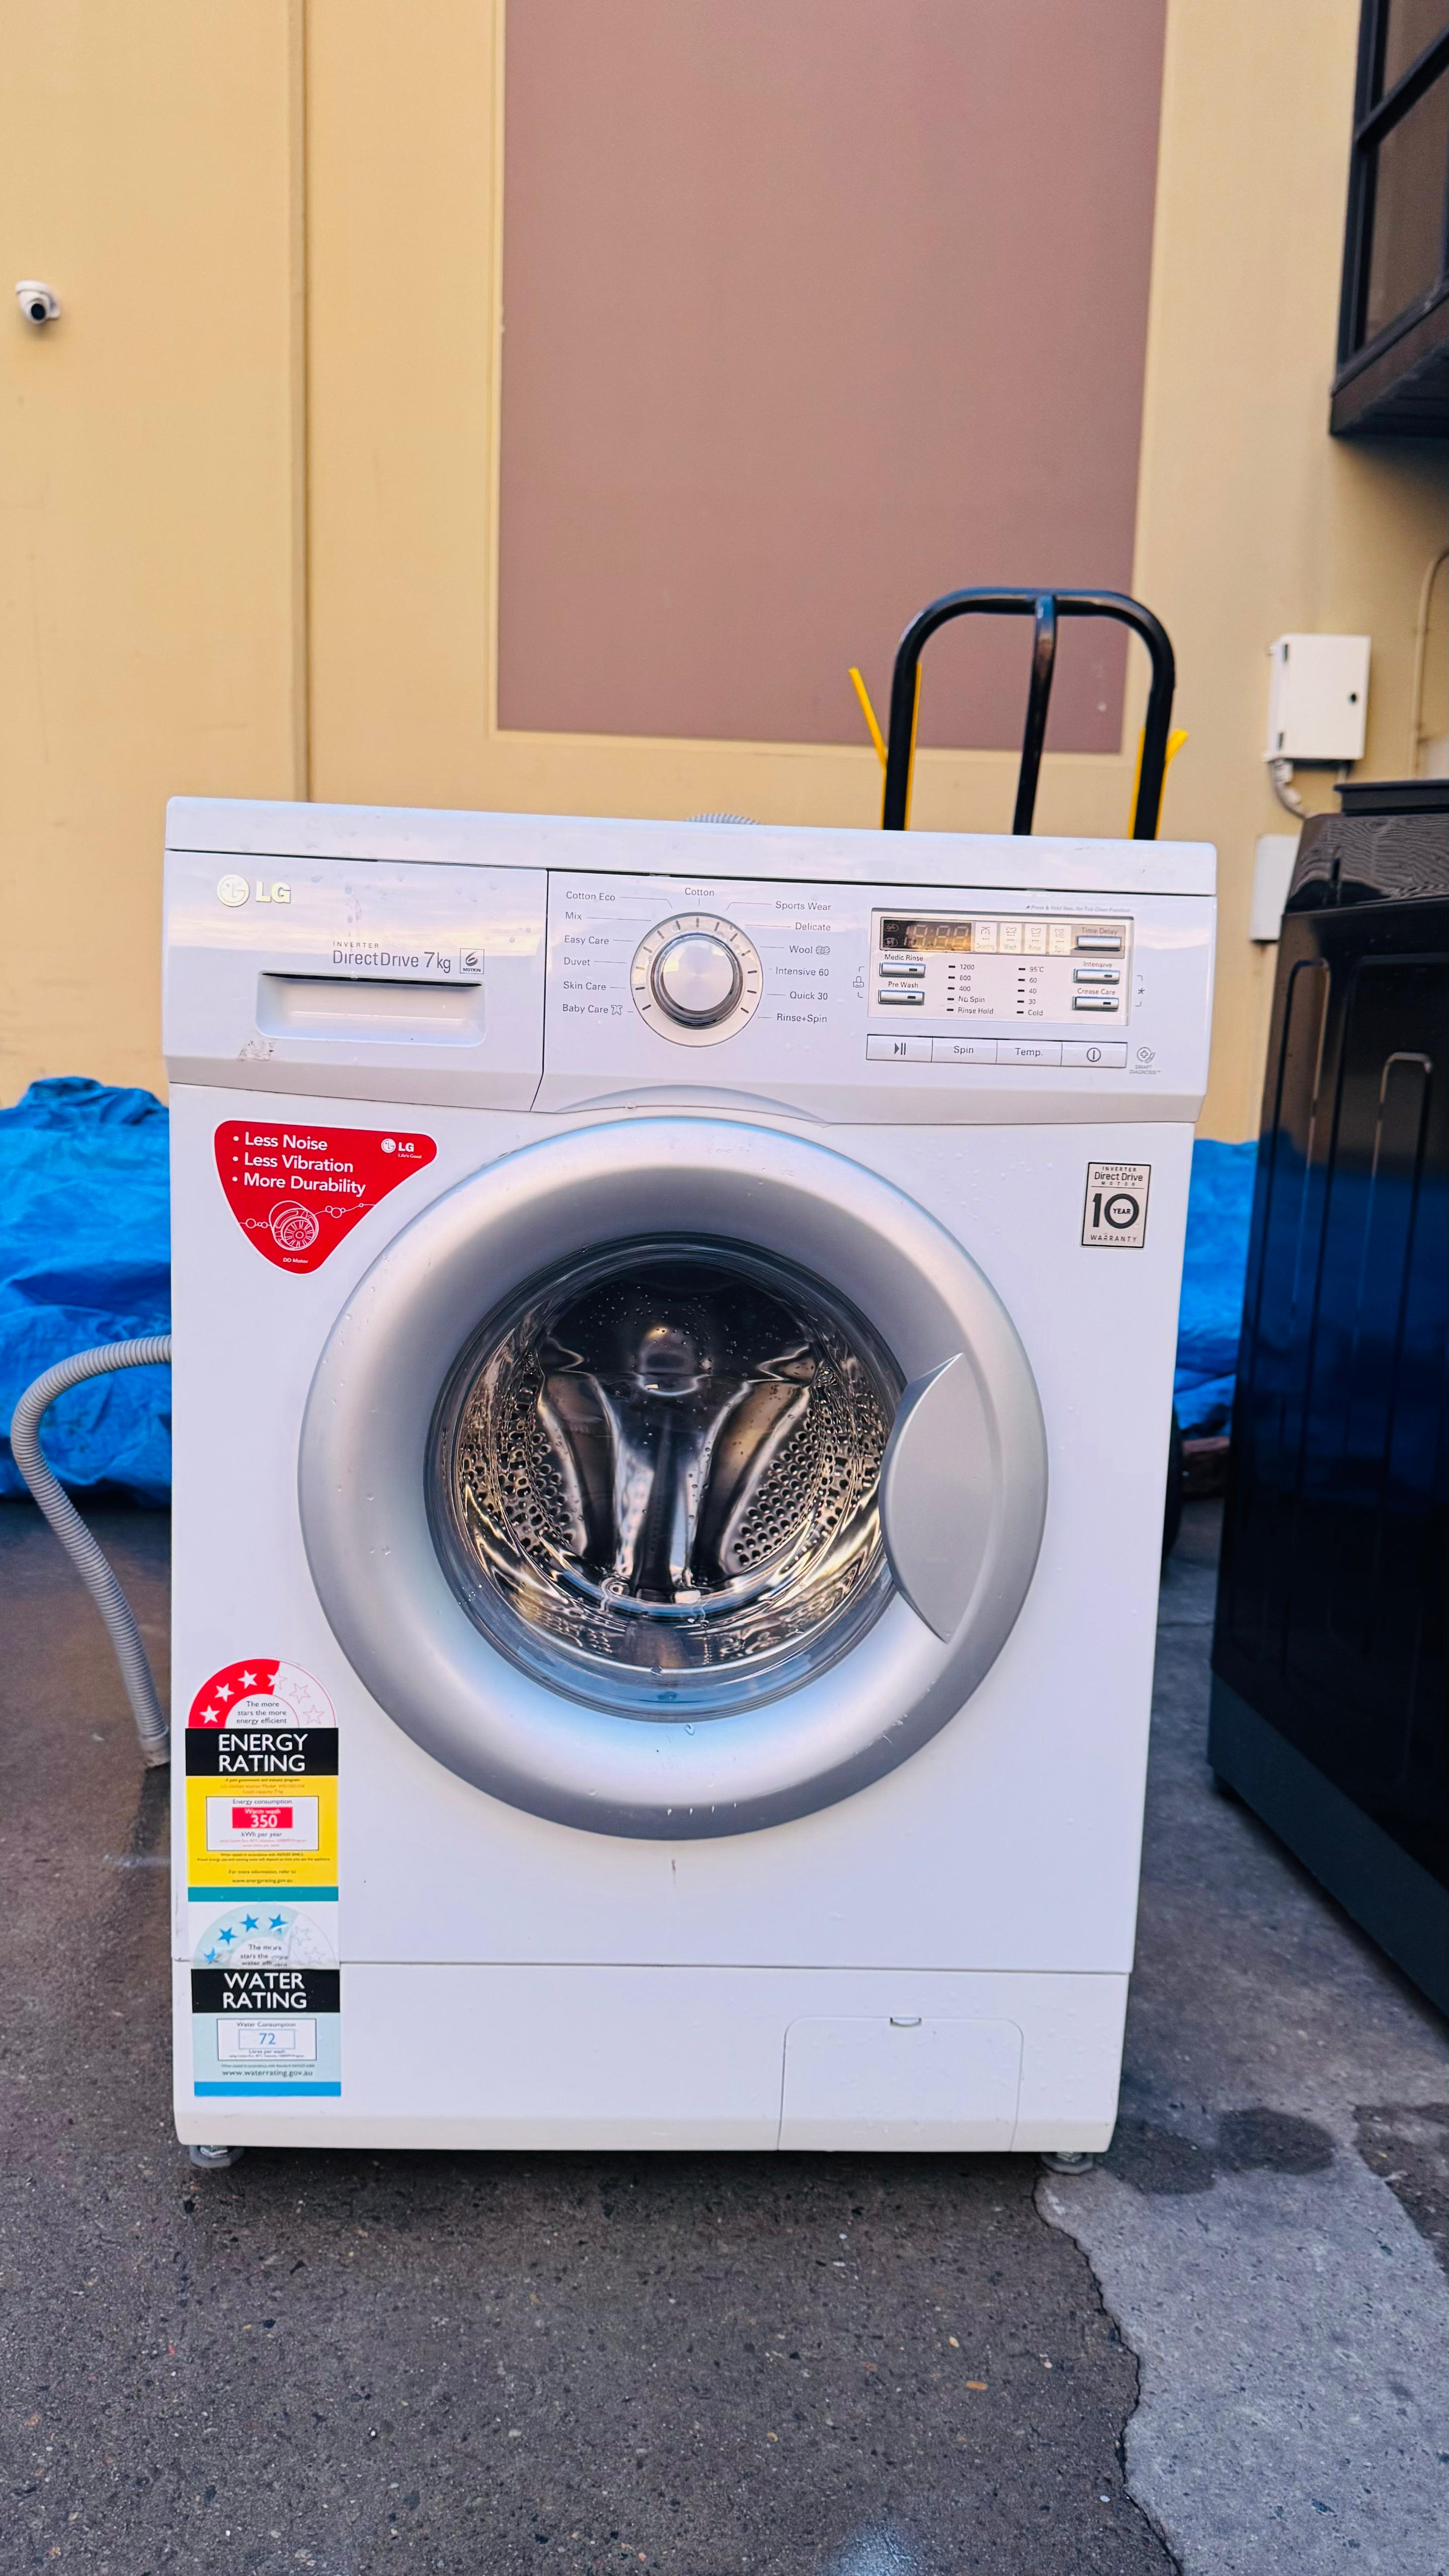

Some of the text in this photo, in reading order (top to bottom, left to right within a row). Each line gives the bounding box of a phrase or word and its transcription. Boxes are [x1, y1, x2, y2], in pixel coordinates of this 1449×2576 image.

[256, 881, 291, 904] LG
[566, 892, 596, 900] Cotton
[685, 888, 714, 897] Cotton
[776, 901, 831, 911] Sports Wear
[565, 912, 582, 920] Mix
[795, 922, 831, 931] Delicate
[333, 941, 379, 949] INVERTER
[565, 935, 609, 945] Easy Care
[789, 945, 813, 953] Wool
[564, 957, 590, 966] Duvet
[776, 967, 816, 976] Intensive
[564, 981, 606, 990] Skin Care
[790, 991, 815, 1000] Quick
[562, 1004, 608, 1014] Baby Care
[777, 1013, 827, 1023] Rinse+Spin
[953, 1045, 974, 1055] Spin
[1015, 1047, 1042, 1057] Temp.
[245, 1132, 328, 1151] Less Noise
[398, 1142, 414, 1152] LG
[244, 1152, 353, 1173] Less Vibration
[1094, 1172, 1143, 1181] Direct Drive
[244, 1172, 366, 1197] More Durability
[1093, 1193, 1139, 1229] 10
[218, 1733, 308, 1751] ENERGY
[218, 1754, 305, 1773] RATING
[251, 1815, 278, 1828] 350
[224, 1972, 305, 1989] WATER
[223, 1992, 306, 2008] RATING
[259, 2033, 276, 2045] 72
[222, 2069, 313, 2077] www.waterrating.gov.au
